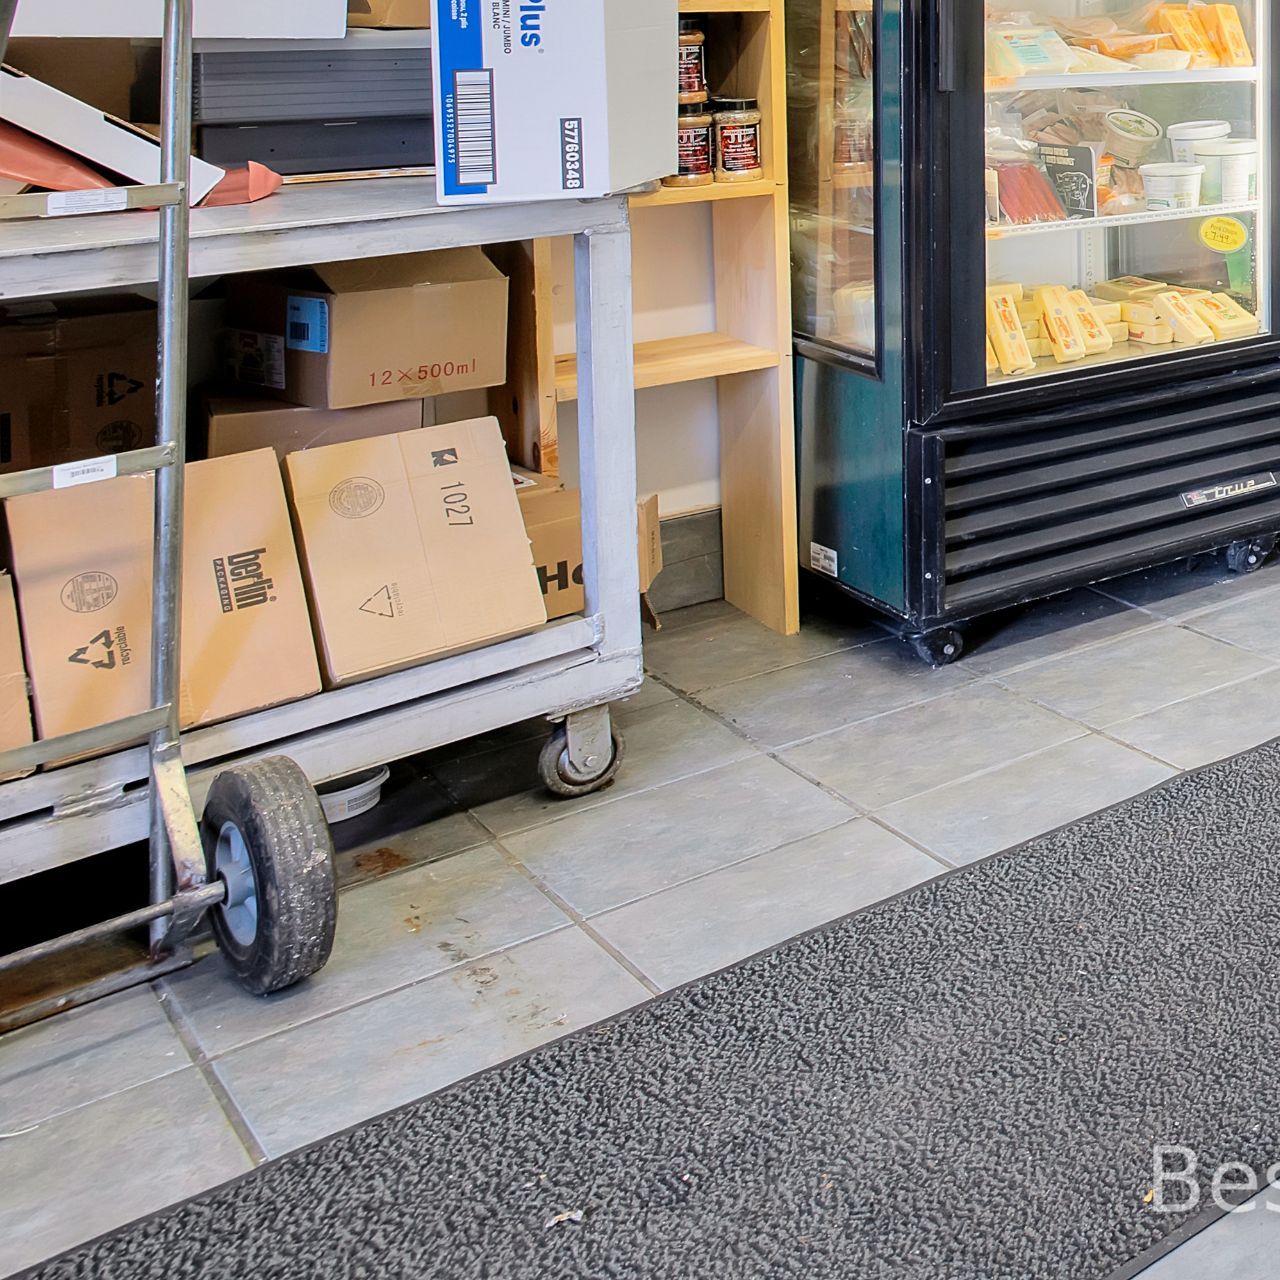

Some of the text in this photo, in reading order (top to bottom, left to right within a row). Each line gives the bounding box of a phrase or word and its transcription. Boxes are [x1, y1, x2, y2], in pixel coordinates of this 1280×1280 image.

[492, 2, 500, 29] BLANC
[502, 0, 510, 19] MINI
[503, 24, 511, 54] JUMBO
[565, 121, 580, 187] 57760348
[440, 481, 473, 526] 1027
[1213, 479, 1257, 501] true
[215, 560, 231, 612] PACKAGING
[227, 548, 273, 610] berlin
[117, 626, 131, 665] recyclable
